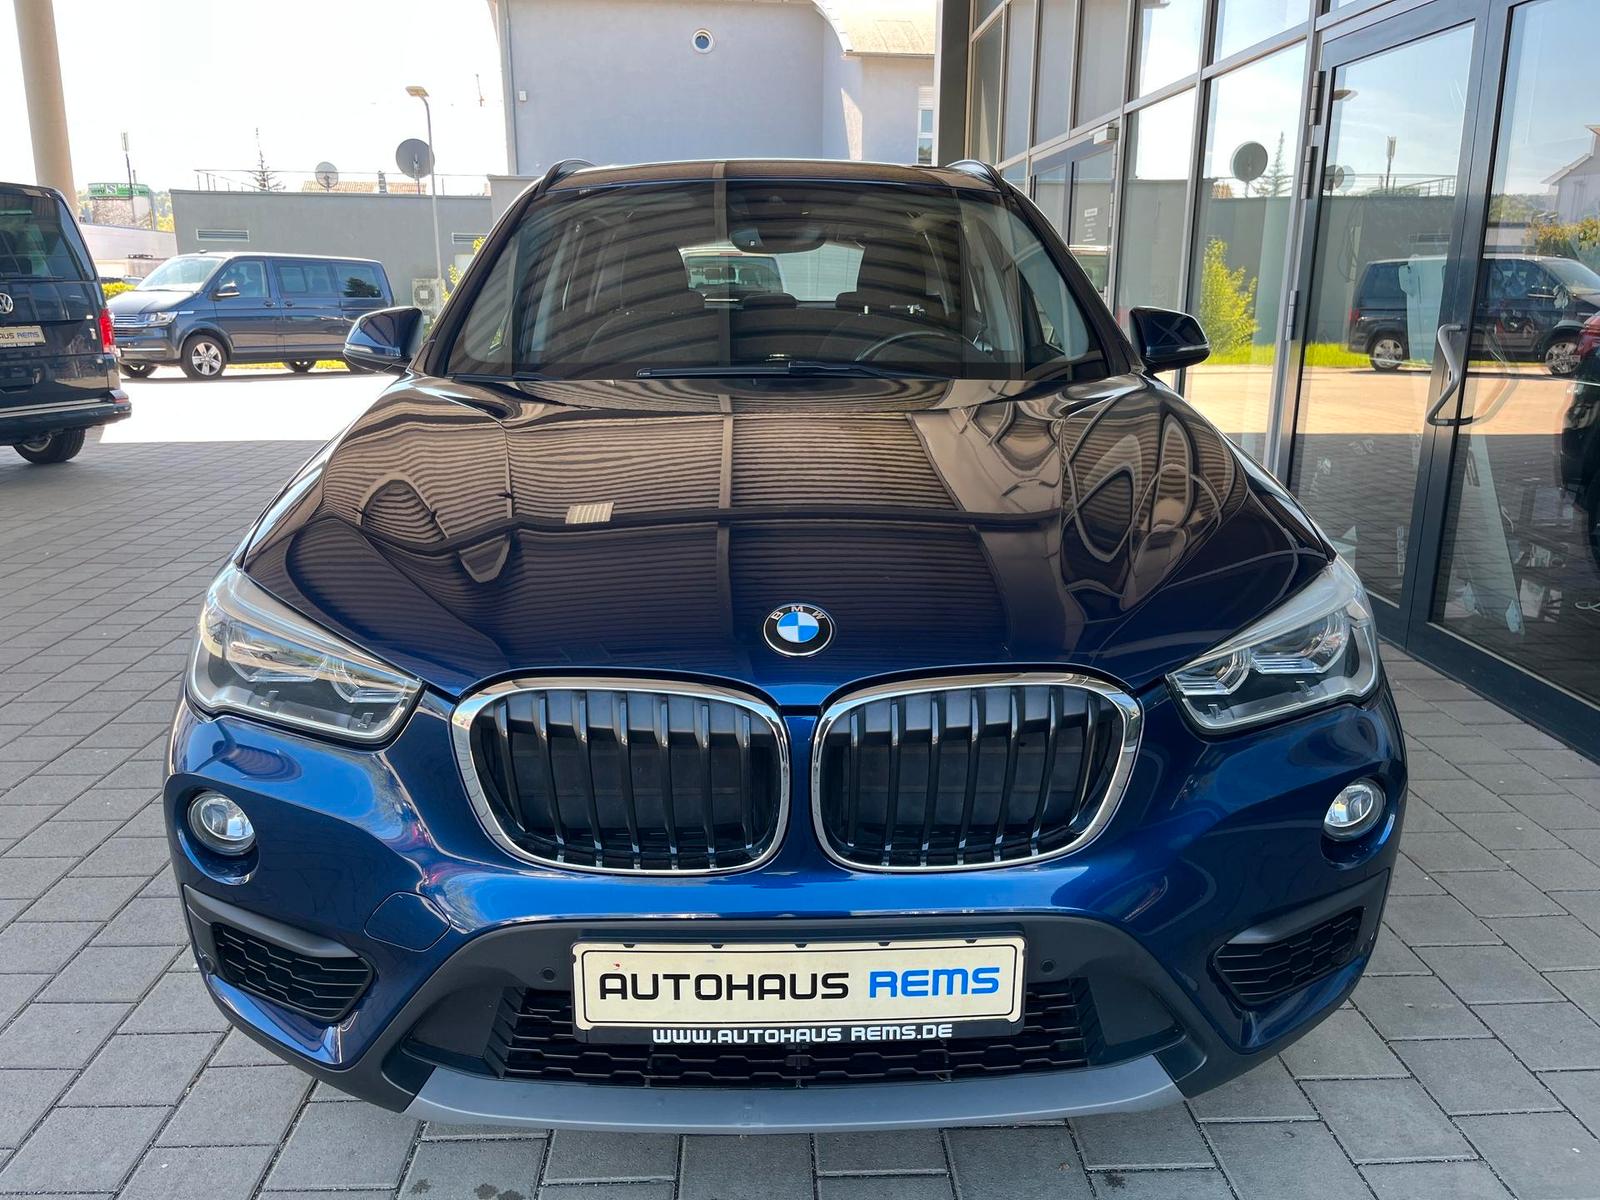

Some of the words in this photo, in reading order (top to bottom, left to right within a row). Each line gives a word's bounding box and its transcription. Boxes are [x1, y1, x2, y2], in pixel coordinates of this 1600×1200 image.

[770, 605, 826, 621] BMW
[599, 972, 850, 1001] AUTOHAUS
[868, 966, 1000, 998] REMS
[652, 1027, 842, 1044] WWW.AUTOHAUS
[850, 1023, 953, 1041] REMS.DE
